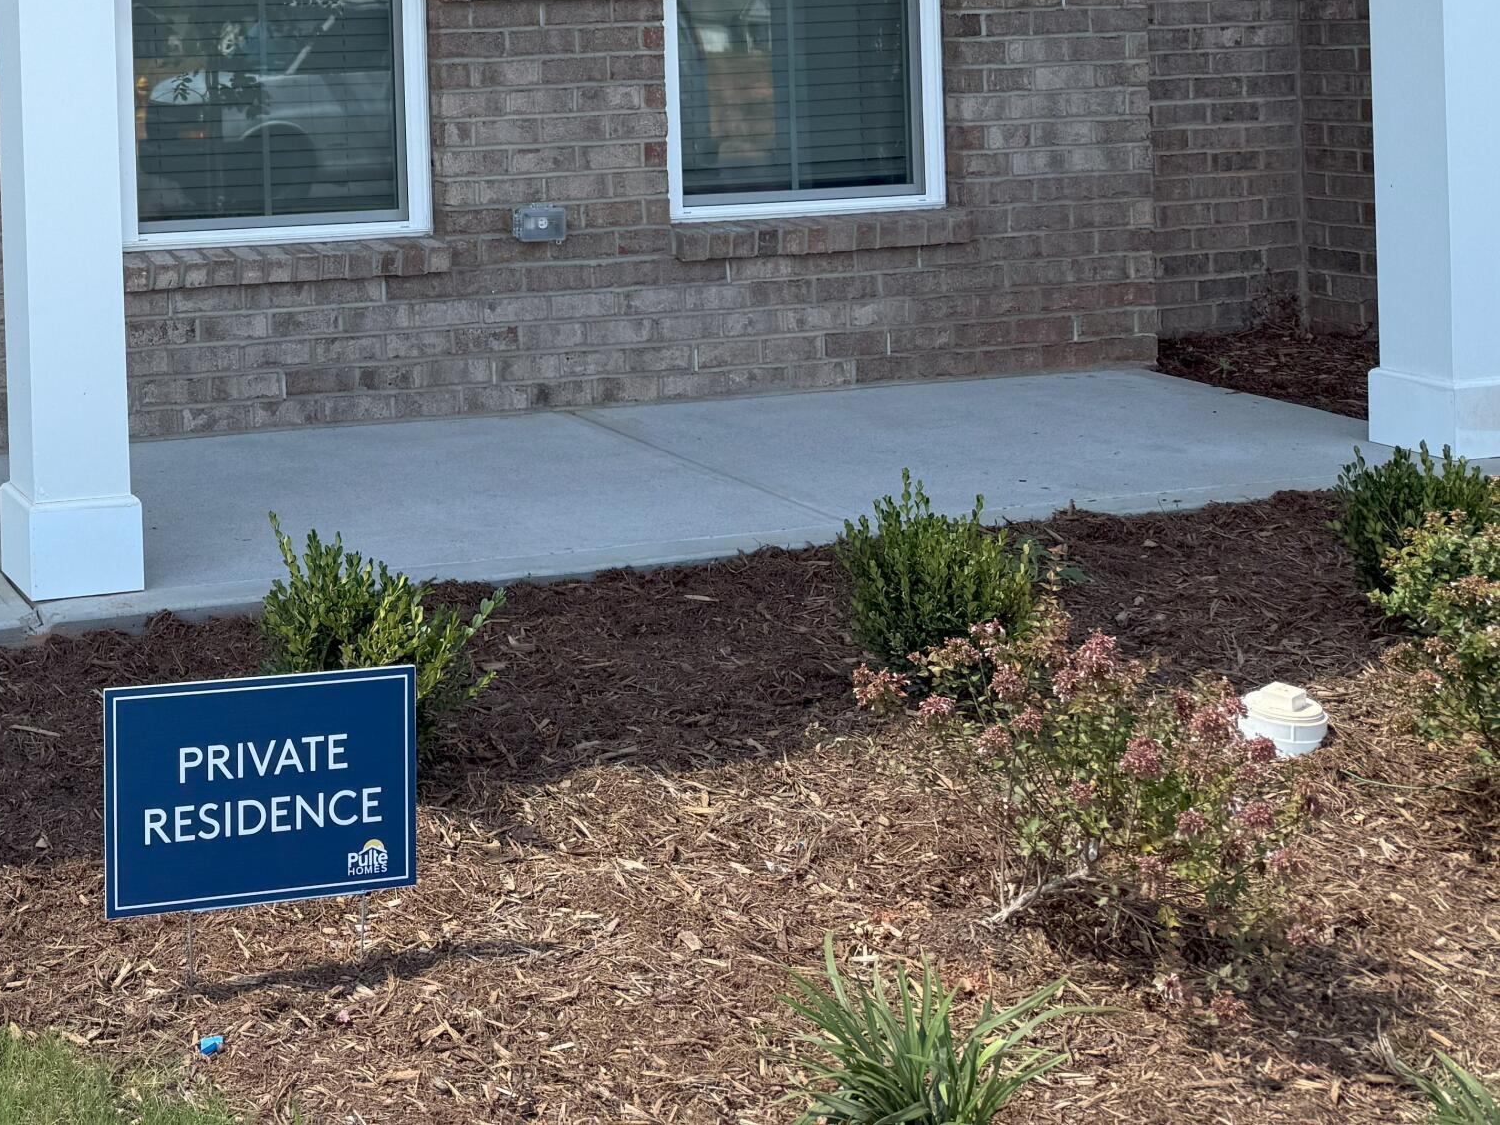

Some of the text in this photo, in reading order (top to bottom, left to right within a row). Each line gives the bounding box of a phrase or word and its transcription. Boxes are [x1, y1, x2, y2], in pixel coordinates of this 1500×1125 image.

[179, 733, 348, 784] PRIVATE
[144, 786, 382, 846] RESIDENCE
[347, 848, 388, 868] Pulte
[347, 864, 388, 876] HOMES
